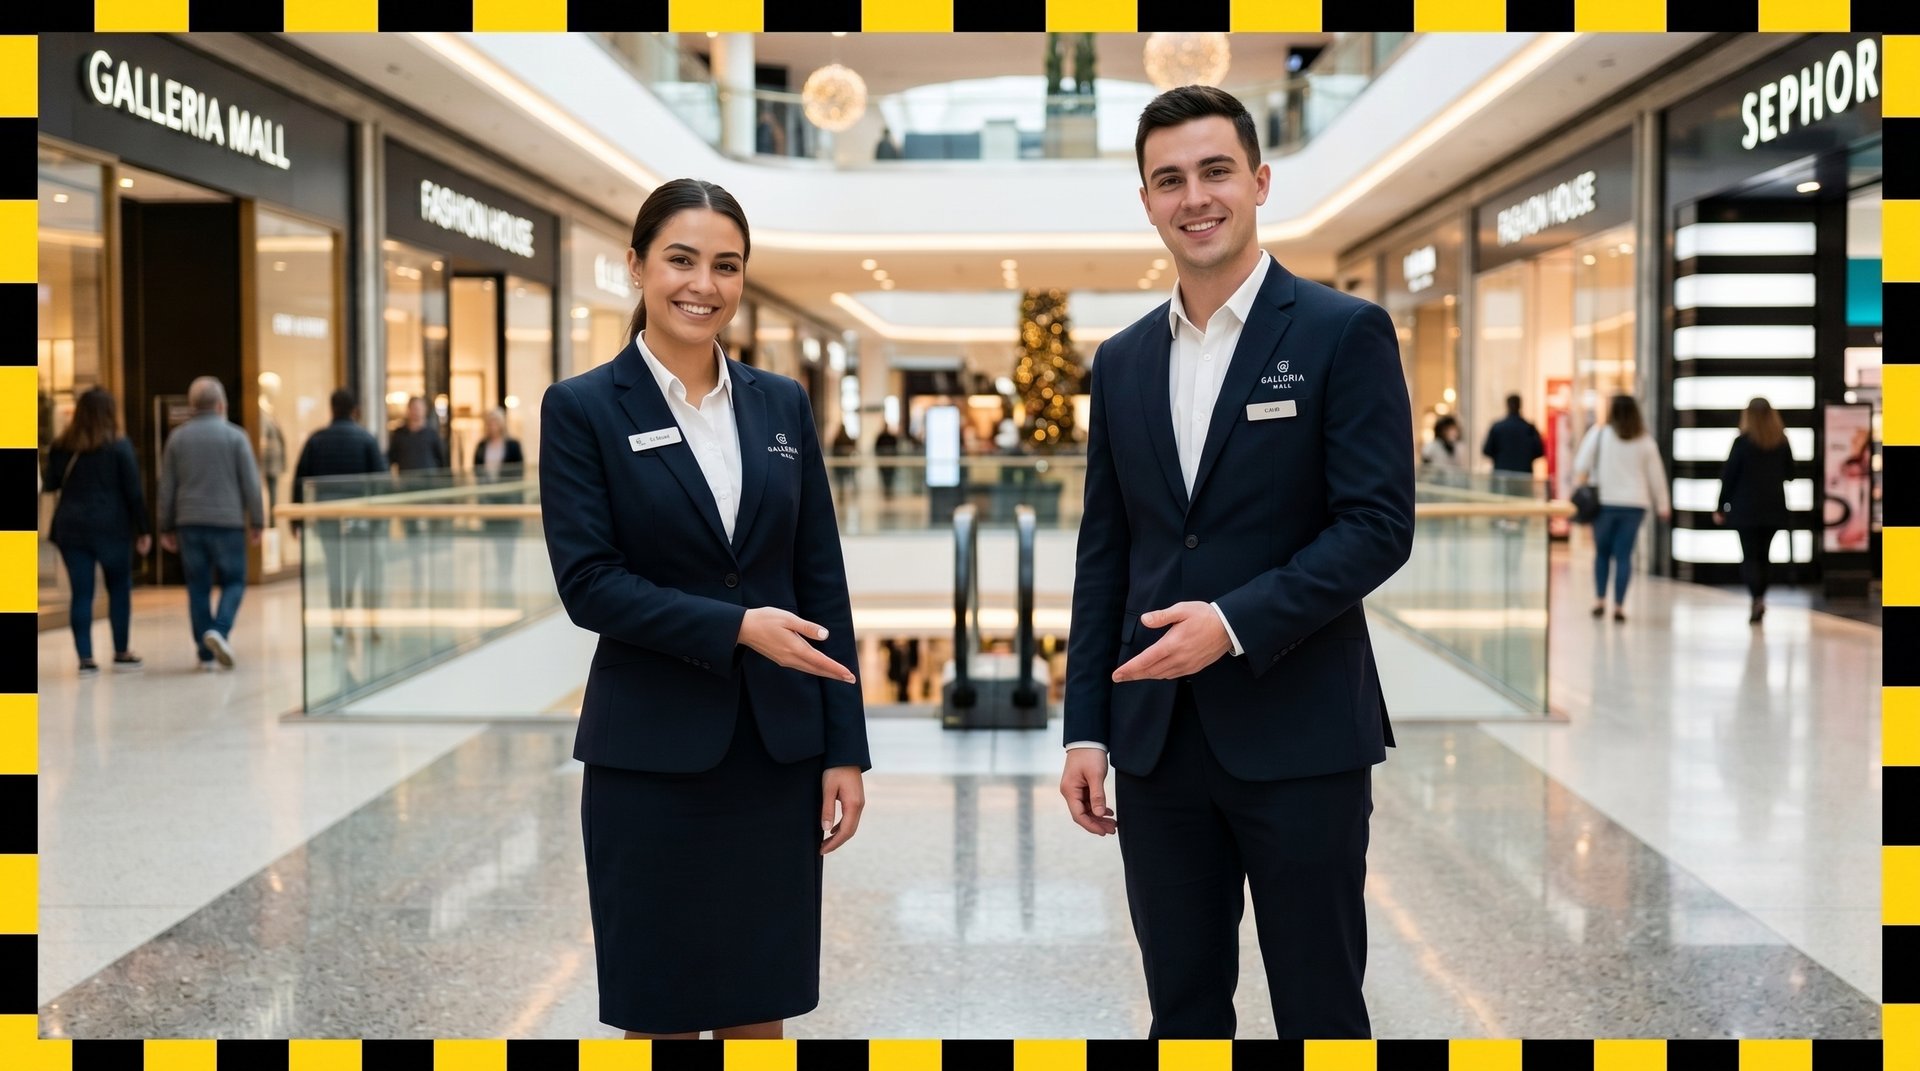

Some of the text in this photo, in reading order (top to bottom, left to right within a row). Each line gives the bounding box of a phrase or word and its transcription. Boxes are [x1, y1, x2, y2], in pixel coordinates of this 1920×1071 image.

[89, 49, 291, 171] GALLERIA MALL
[1741, 38, 1879, 150] SEPHOR
[420, 179, 536, 259] FASHION HOUSE
[1547, 170, 1597, 226] HOUSE
